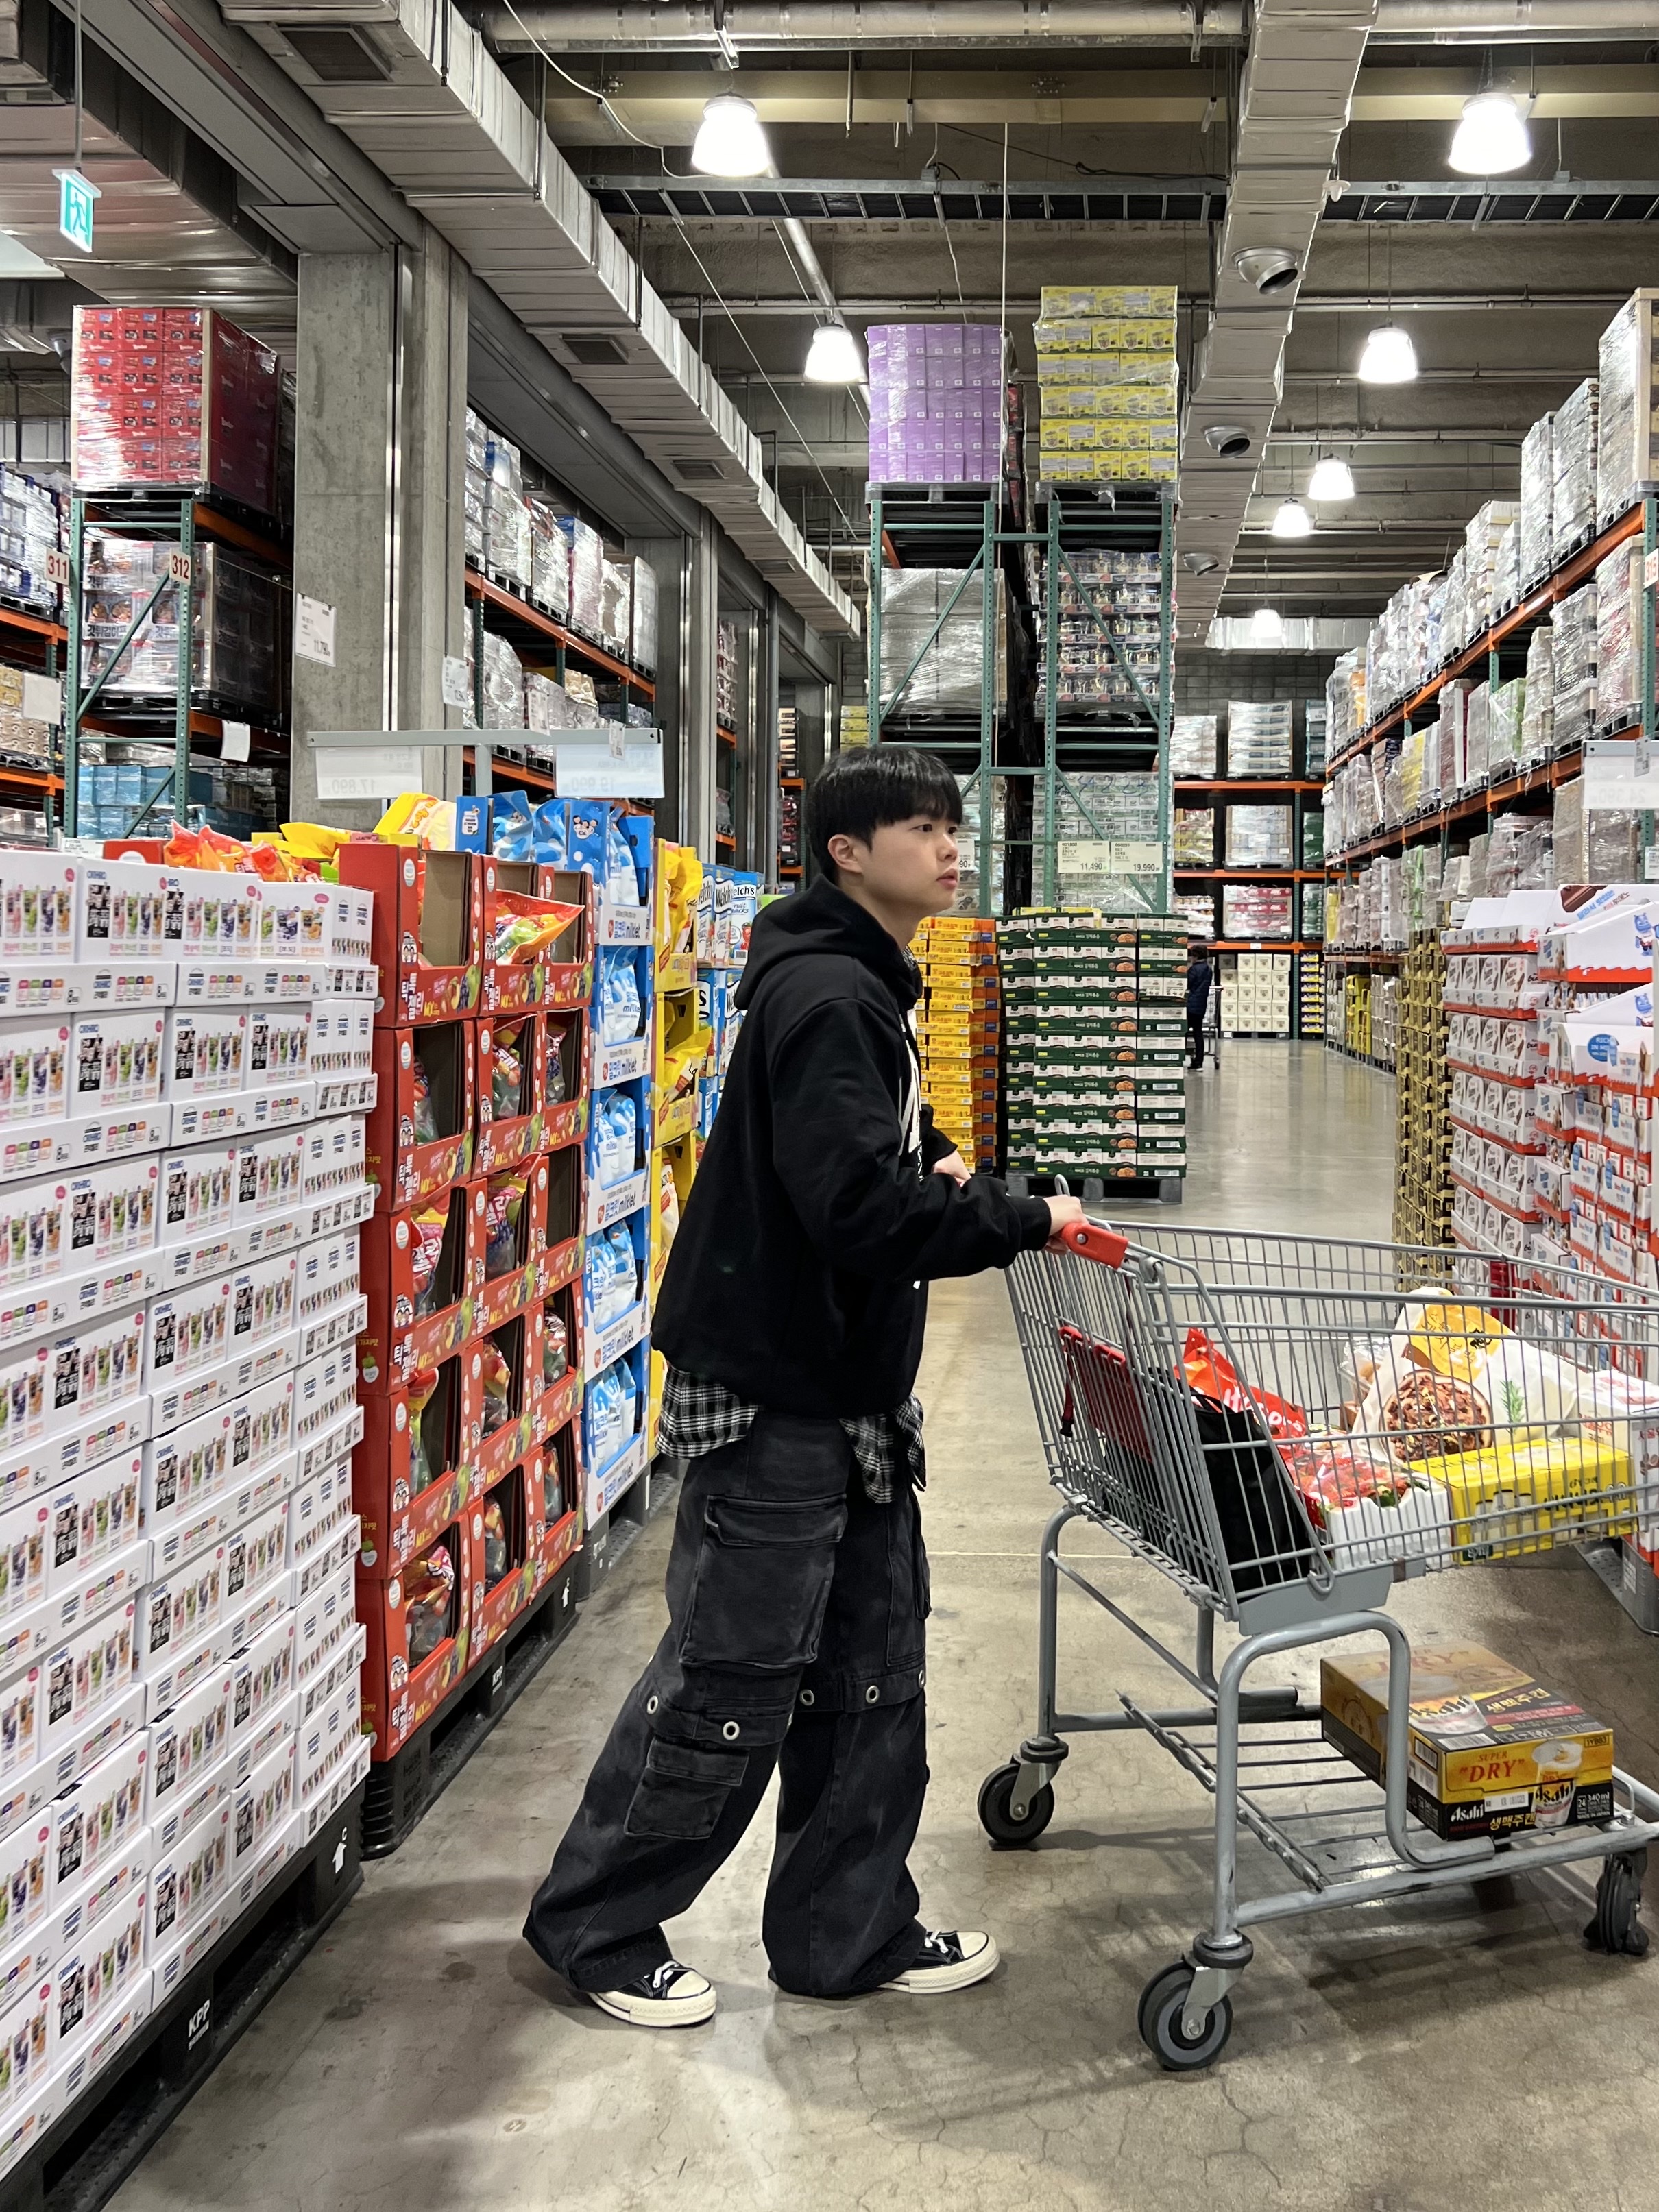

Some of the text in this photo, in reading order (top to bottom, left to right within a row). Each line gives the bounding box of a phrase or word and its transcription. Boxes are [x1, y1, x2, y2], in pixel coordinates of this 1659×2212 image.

[47, 555, 68, 579] 311
[172, 555, 189, 579] 312
[1645, 558, 1658, 581] 315
[733, 886, 755, 895] elch's
[1486, 1687, 1551, 1714] 생맥주캔
[1478, 1750, 1507, 1762] SUPER
[1451, 1803, 1484, 1822] Asahi
[1490, 1812, 1536, 1830] 생맥주캔
[188, 1999, 210, 2037] KPP
